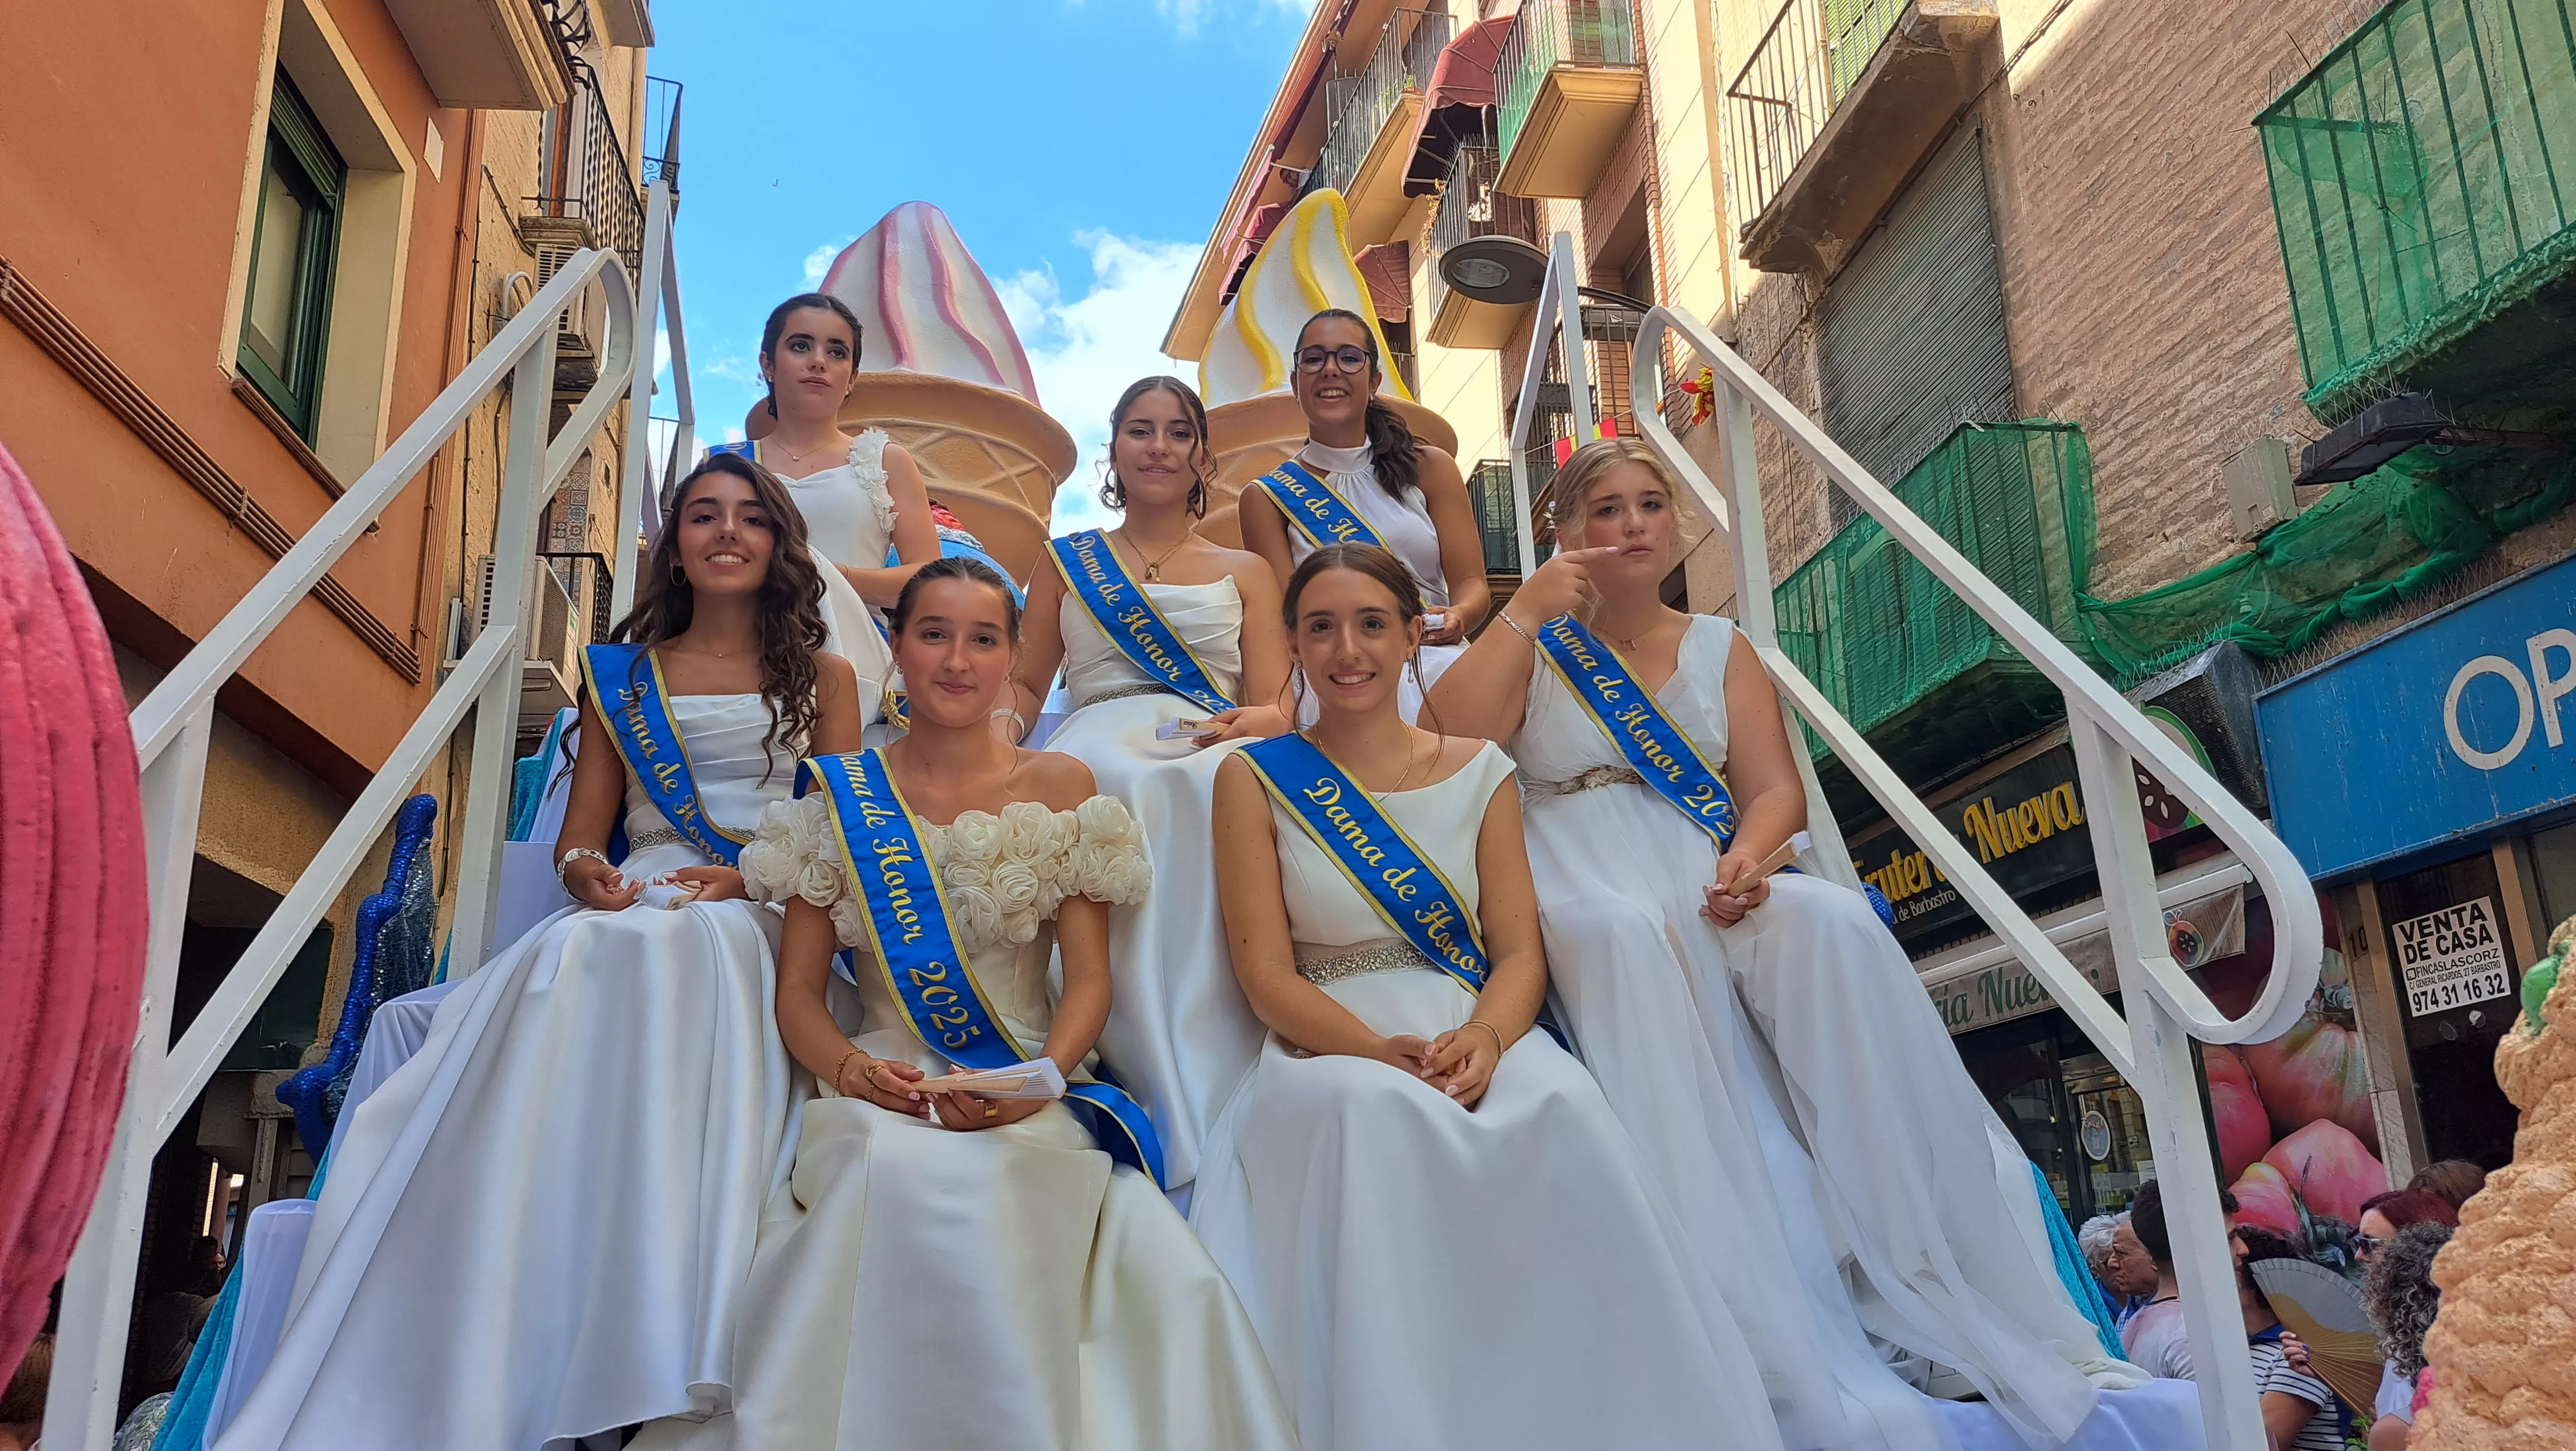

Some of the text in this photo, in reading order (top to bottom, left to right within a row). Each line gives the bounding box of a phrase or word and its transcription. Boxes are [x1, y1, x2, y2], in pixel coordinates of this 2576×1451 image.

[1269, 470, 1330, 520] ama de
[1069, 535, 1107, 584] Dama
[1098, 583, 1124, 606] de
[1118, 606, 1183, 682] Honor
[617, 681, 658, 759] Dama
[653, 763, 681, 794] de
[1543, 613, 1735, 835] Dama de Honor 202
[860, 802, 895, 829] de
[1303, 777, 1385, 867] Dama
[1382, 867, 1417, 902] de
[1963, 781, 2086, 864] Nueva
[872, 837, 923, 945] Honor
[1899, 905, 1910, 921] de
[1909, 889, 1956, 917] Barbastro
[2349, 926, 2368, 957] 10
[2398, 902, 2488, 943] VENTA
[2403, 923, 2494, 965] DE CASA
[2409, 960, 2501, 991] C/ GENERAL RICARDOS, 27 BARBASTRO
[2412, 973, 2505, 1012] 974 31 16 32
[908, 961, 982, 1049] 2025
